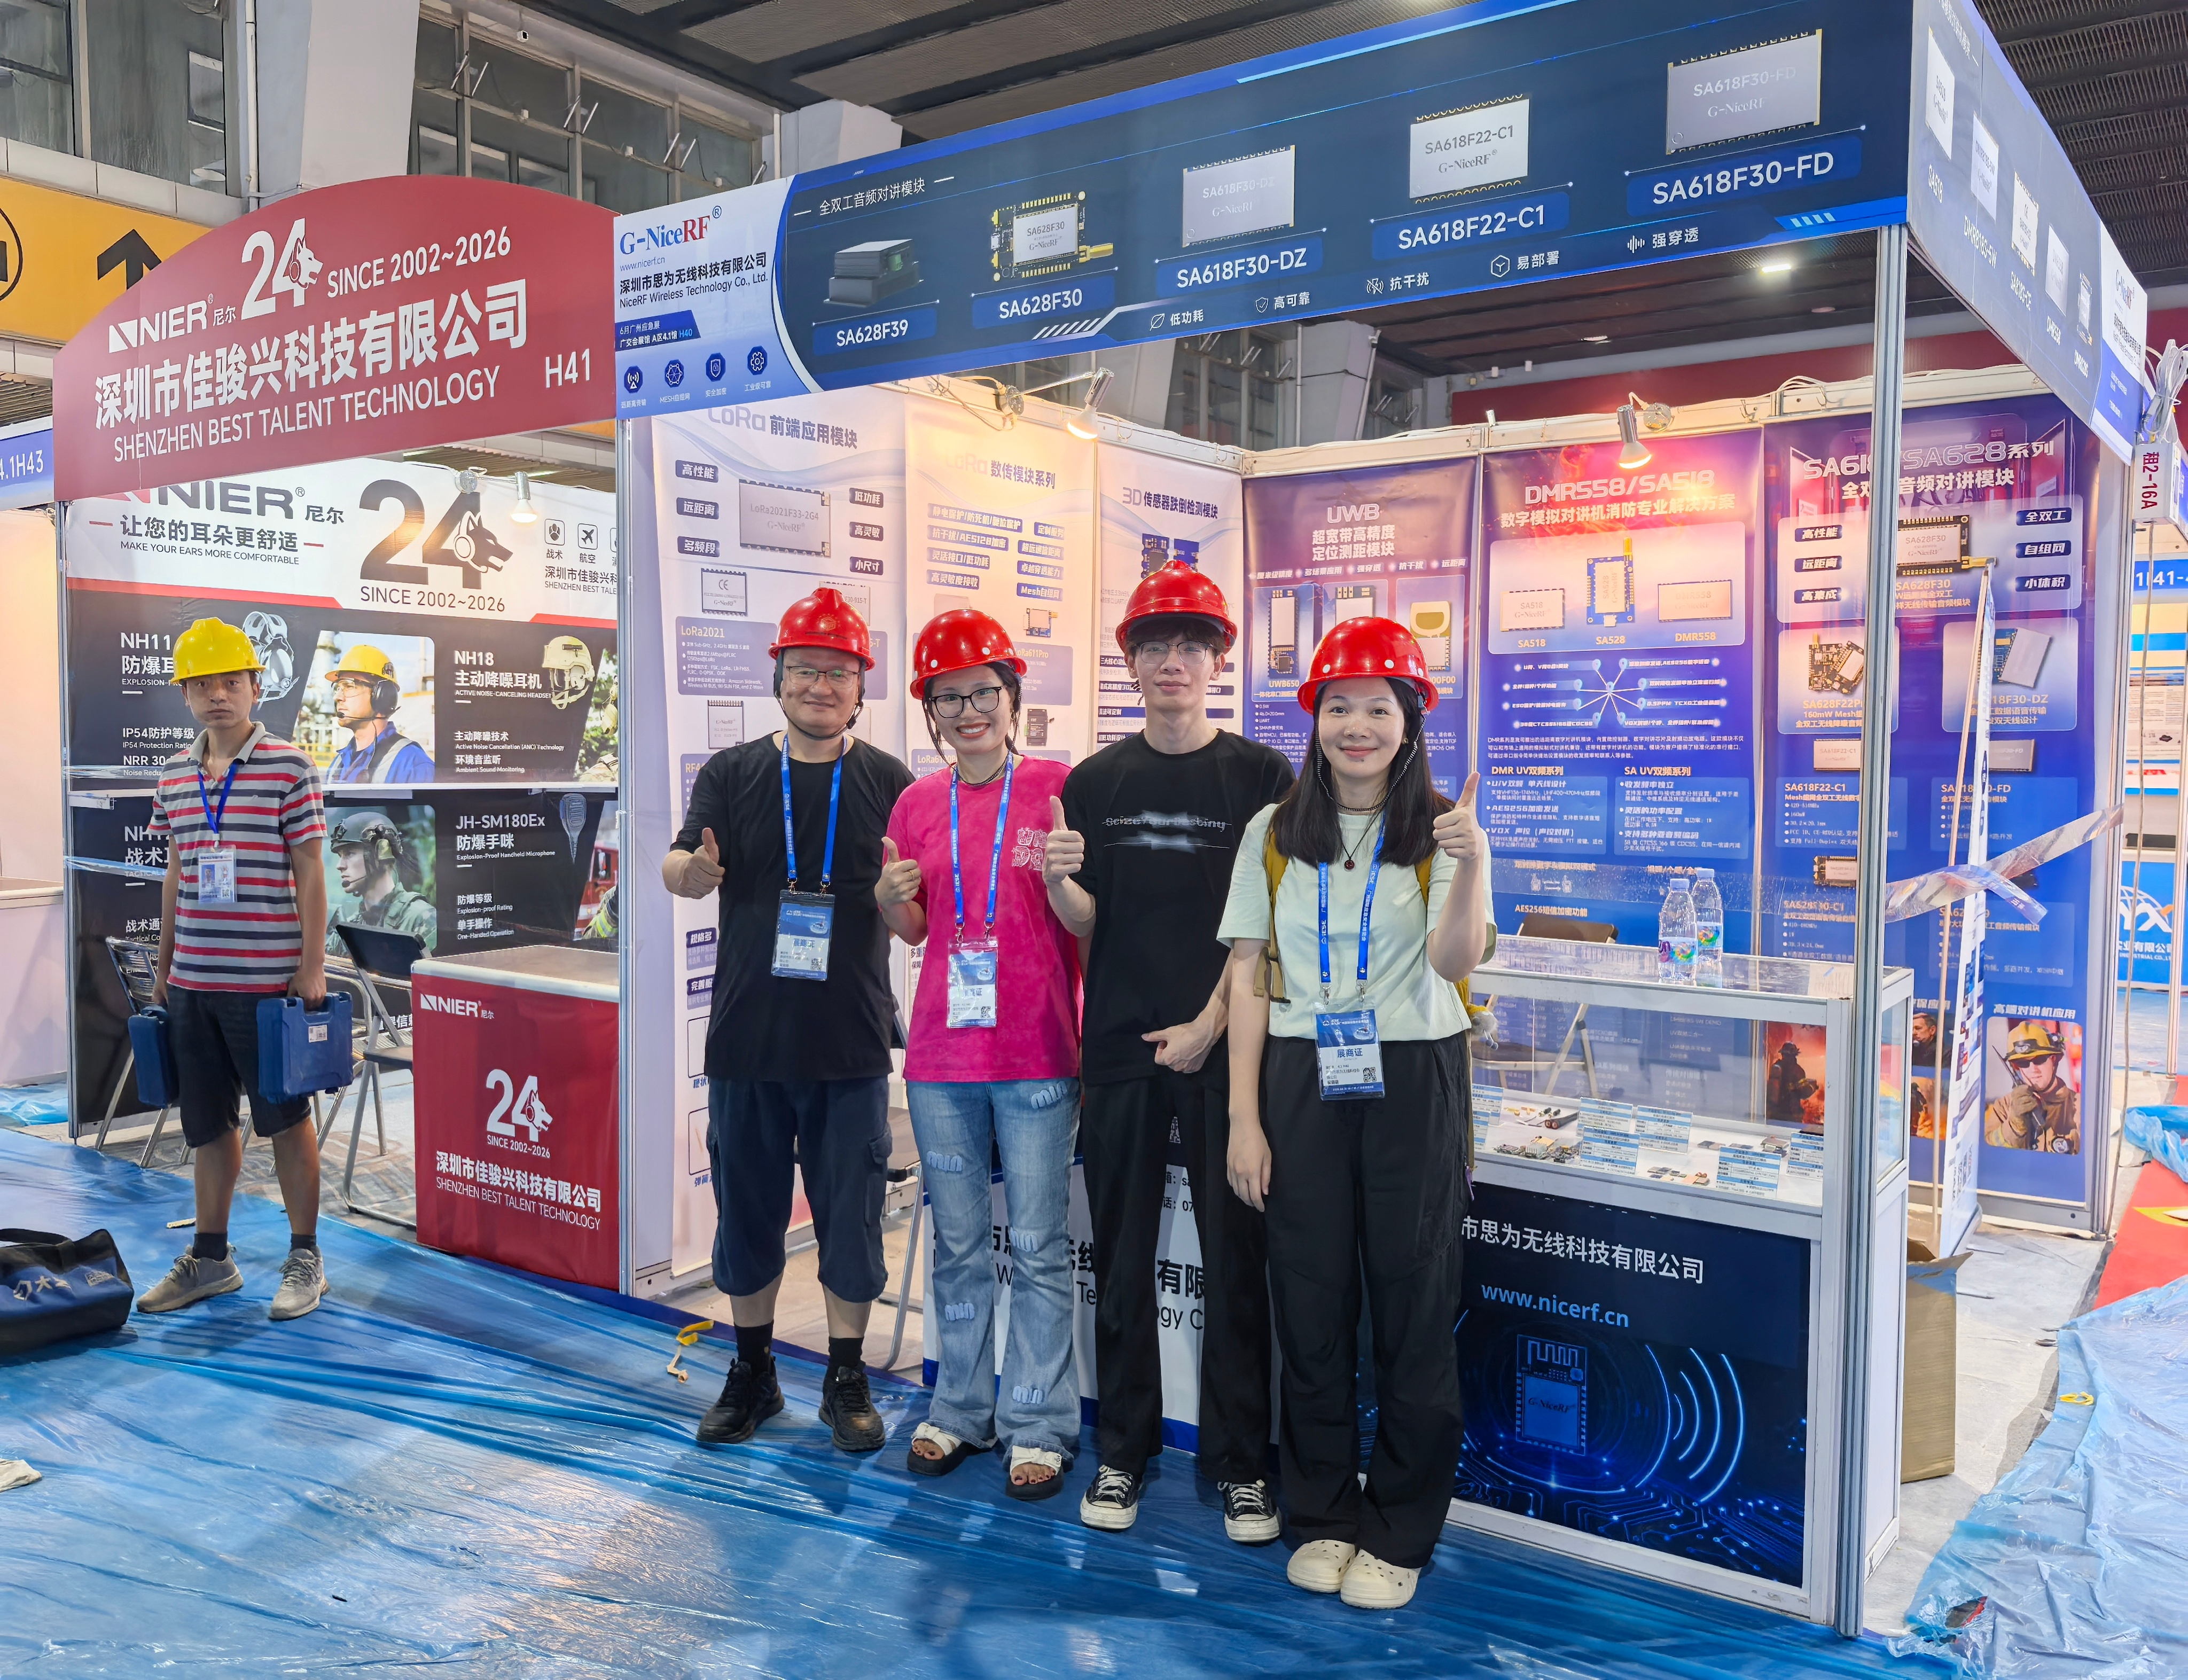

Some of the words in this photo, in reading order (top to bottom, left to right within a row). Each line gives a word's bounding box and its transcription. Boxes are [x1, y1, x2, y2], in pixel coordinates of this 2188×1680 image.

[1693, 66, 1796, 97] SA618F30-FD
[1425, 125, 1514, 154] SA618F22-C1
[1653, 151, 1834, 205] SA618F30-FD
[1202, 176, 1275, 199] SA618F30-DZ
[819, 177, 925, 216] 全双工音频对讲模块
[1027, 221, 1065, 237] SA628F30
[1398, 205, 1545, 250] SA618F22-C1
[1652, 226, 1699, 249] 强穿透
[327, 258, 384, 298] SINCE
[391, 227, 511, 283] 2002~2026
[620, 256, 665, 271] www.nicerf.cn
[1177, 248, 1308, 288] SA618F30-DZ
[1517, 250, 1560, 270] 易部署
[620, 252, 767, 295] 深圳市思为无线科技有限公司
[1390, 272, 1430, 291] 抗干扰
[620, 292, 647, 308] NiceRF
[650, 288, 683, 303] Wireless
[686, 279, 732, 297] Technology
[734, 276, 750, 287] Co.,
[753, 272, 768, 283] Ltd.
[999, 288, 1083, 319] SA628F30
[1274, 291, 1310, 310] 高可靠
[213, 305, 236, 326] 尼尔
[1170, 308, 1204, 326] 低功耗
[620, 320, 660, 334] 6月广州应急展
[837, 319, 909, 347] SA628F39
[620, 336, 651, 348] 广交会展馆
[652, 330, 677, 343] A区4.1馆
[679, 329, 693, 338] H40
[95, 279, 527, 430] 深圳市佳骏兴科技有限公司
[545, 348, 591, 388] H41
[114, 421, 202, 462] SHENZHEN
[209, 412, 253, 441] BEST
[259, 398, 335, 435] TALENT
[341, 365, 500, 423] TECHNOLOGY
[770, 415, 858, 449] 前端应用模块
[682, 464, 715, 480] 高性能
[991, 460, 1056, 489] 数传模块系列
[1526, 470, 1715, 505] DMR558/SA518
[855, 491, 881, 506] 低功耗
[1122, 487, 1142, 506] 3D
[1144, 491, 1218, 519] 传感器跌倒检测模块
[304, 505, 345, 525] 尼尔
[683, 501, 715, 516] 远距离
[1327, 504, 1380, 523] UWB
[1501, 493, 1736, 529] 数字模拟对讲机消防专业解决方案
[2025, 510, 2066, 523] 全双工
[120, 514, 299, 552] 让您的耳朵更舒适
[855, 525, 880, 539] 高灵敏
[1038, 525, 1064, 537] 定制服务
[1312, 524, 1395, 545] 超宽带高精度
[1802, 527, 1837, 539] 高性能
[684, 540, 716, 555] 多频段
[1905, 535, 1946, 544] SA628F30
[120, 540, 149, 552] MAKE
[150, 543, 177, 554] YOUR
[179, 545, 203, 557] EARS
[205, 547, 232, 559] MORE
[234, 551, 300, 565] COMFORTABLE
[546, 549, 563, 560] 战术
[580, 553, 596, 565] 航空
[1312, 542, 1395, 561] 定位测距模块
[2025, 543, 2065, 555] 自组网
[855, 559, 880, 573] 小尺寸
[1399, 561, 1424, 570] 抗干扰
[1802, 558, 1837, 569] 远距离
[544, 581, 581, 591] SHENZHEN
[583, 583, 599, 592] BEST
[931, 572, 978, 588] 高灵敏度接收
[1896, 580, 1950, 591] SA628F30
[2025, 576, 2065, 589] 小体积
[361, 586, 411, 605] SINCE
[417, 590, 505, 613] 2002~2026
[1021, 586, 1060, 599] Mesh自组网
[1520, 601, 1543, 610] SA518
[681, 626, 725, 638] LoRa2021
[1675, 632, 1716, 642] DMR558
[121, 632, 171, 651] NH11
[1518, 638, 1546, 648] SA518
[1596, 636, 1626, 645] SA528
[455, 650, 494, 666] NH18
[455, 670, 542, 690] 主动降噪耳机
[1803, 710, 1832, 718] 160mW
[123, 727, 194, 739] IP54防护等级
[455, 730, 509, 741] 主动降噪技术
[123, 755, 149, 765] NRR
[455, 754, 501, 765] 环境音监听
[1491, 766, 1514, 775] DMR
[1517, 766, 1564, 776] UV双频系列
[1624, 767, 1637, 776] SA
[1639, 767, 1691, 776] UV双频系列
[1785, 783, 1846, 792] SA618F22-C1
[456, 813, 546, 830] JH-SM180Ex
[456, 833, 514, 852] 防爆手咪
[526, 850, 556, 858] Microphone
[457, 893, 493, 905] 防爆等级
[497, 904, 513, 912] Rating
[457, 918, 493, 931] 单手操作
[481, 1010, 494, 1019] 尼尔
[1338, 1048, 1363, 1058] 展商证
[487, 1135, 509, 1150] SINCE
[510, 1139, 550, 1158] 2002~2026
[435, 1150, 601, 1213] 深圳市佳骏兴科技有限公司
[436, 1177, 480, 1199] SHENZHEN
[481, 1188, 503, 1204] BEST
[504, 1194, 537, 1213] TALENT
[538, 1202, 600, 1230] TECHNOLOGY
[1481, 1284, 1629, 1328] www.nicerf.cn
